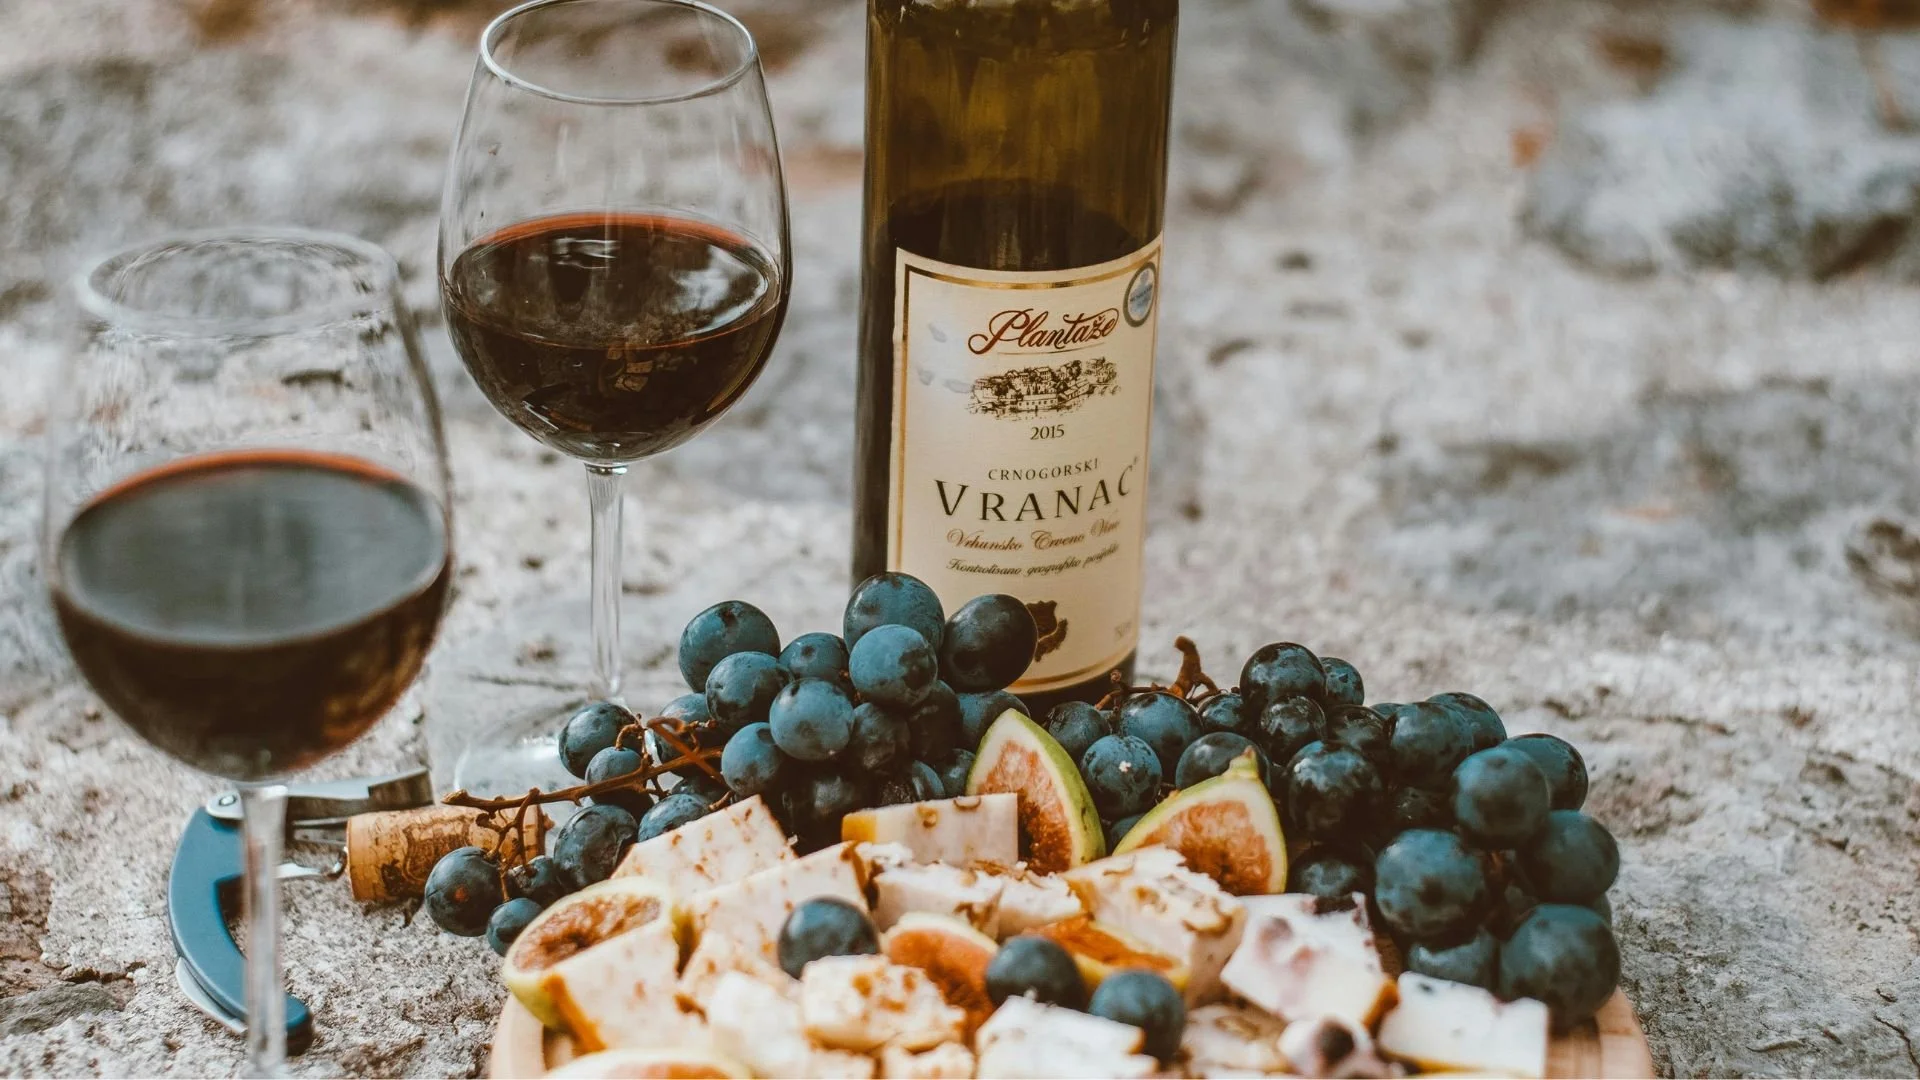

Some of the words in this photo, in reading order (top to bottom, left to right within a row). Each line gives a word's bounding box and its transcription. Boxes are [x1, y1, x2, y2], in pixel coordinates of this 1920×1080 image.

[968, 308, 1119, 354] Plantaže
[1030, 424, 1065, 440] 2015
[988, 457, 1098, 481] CRNOGORSKI
[934, 464, 1134, 522] VRANAC
[946, 528, 1024, 552] Vrhunsko
[1030, 530, 1085, 550] Crveno
[945, 558, 1022, 575] Kontrolisano
